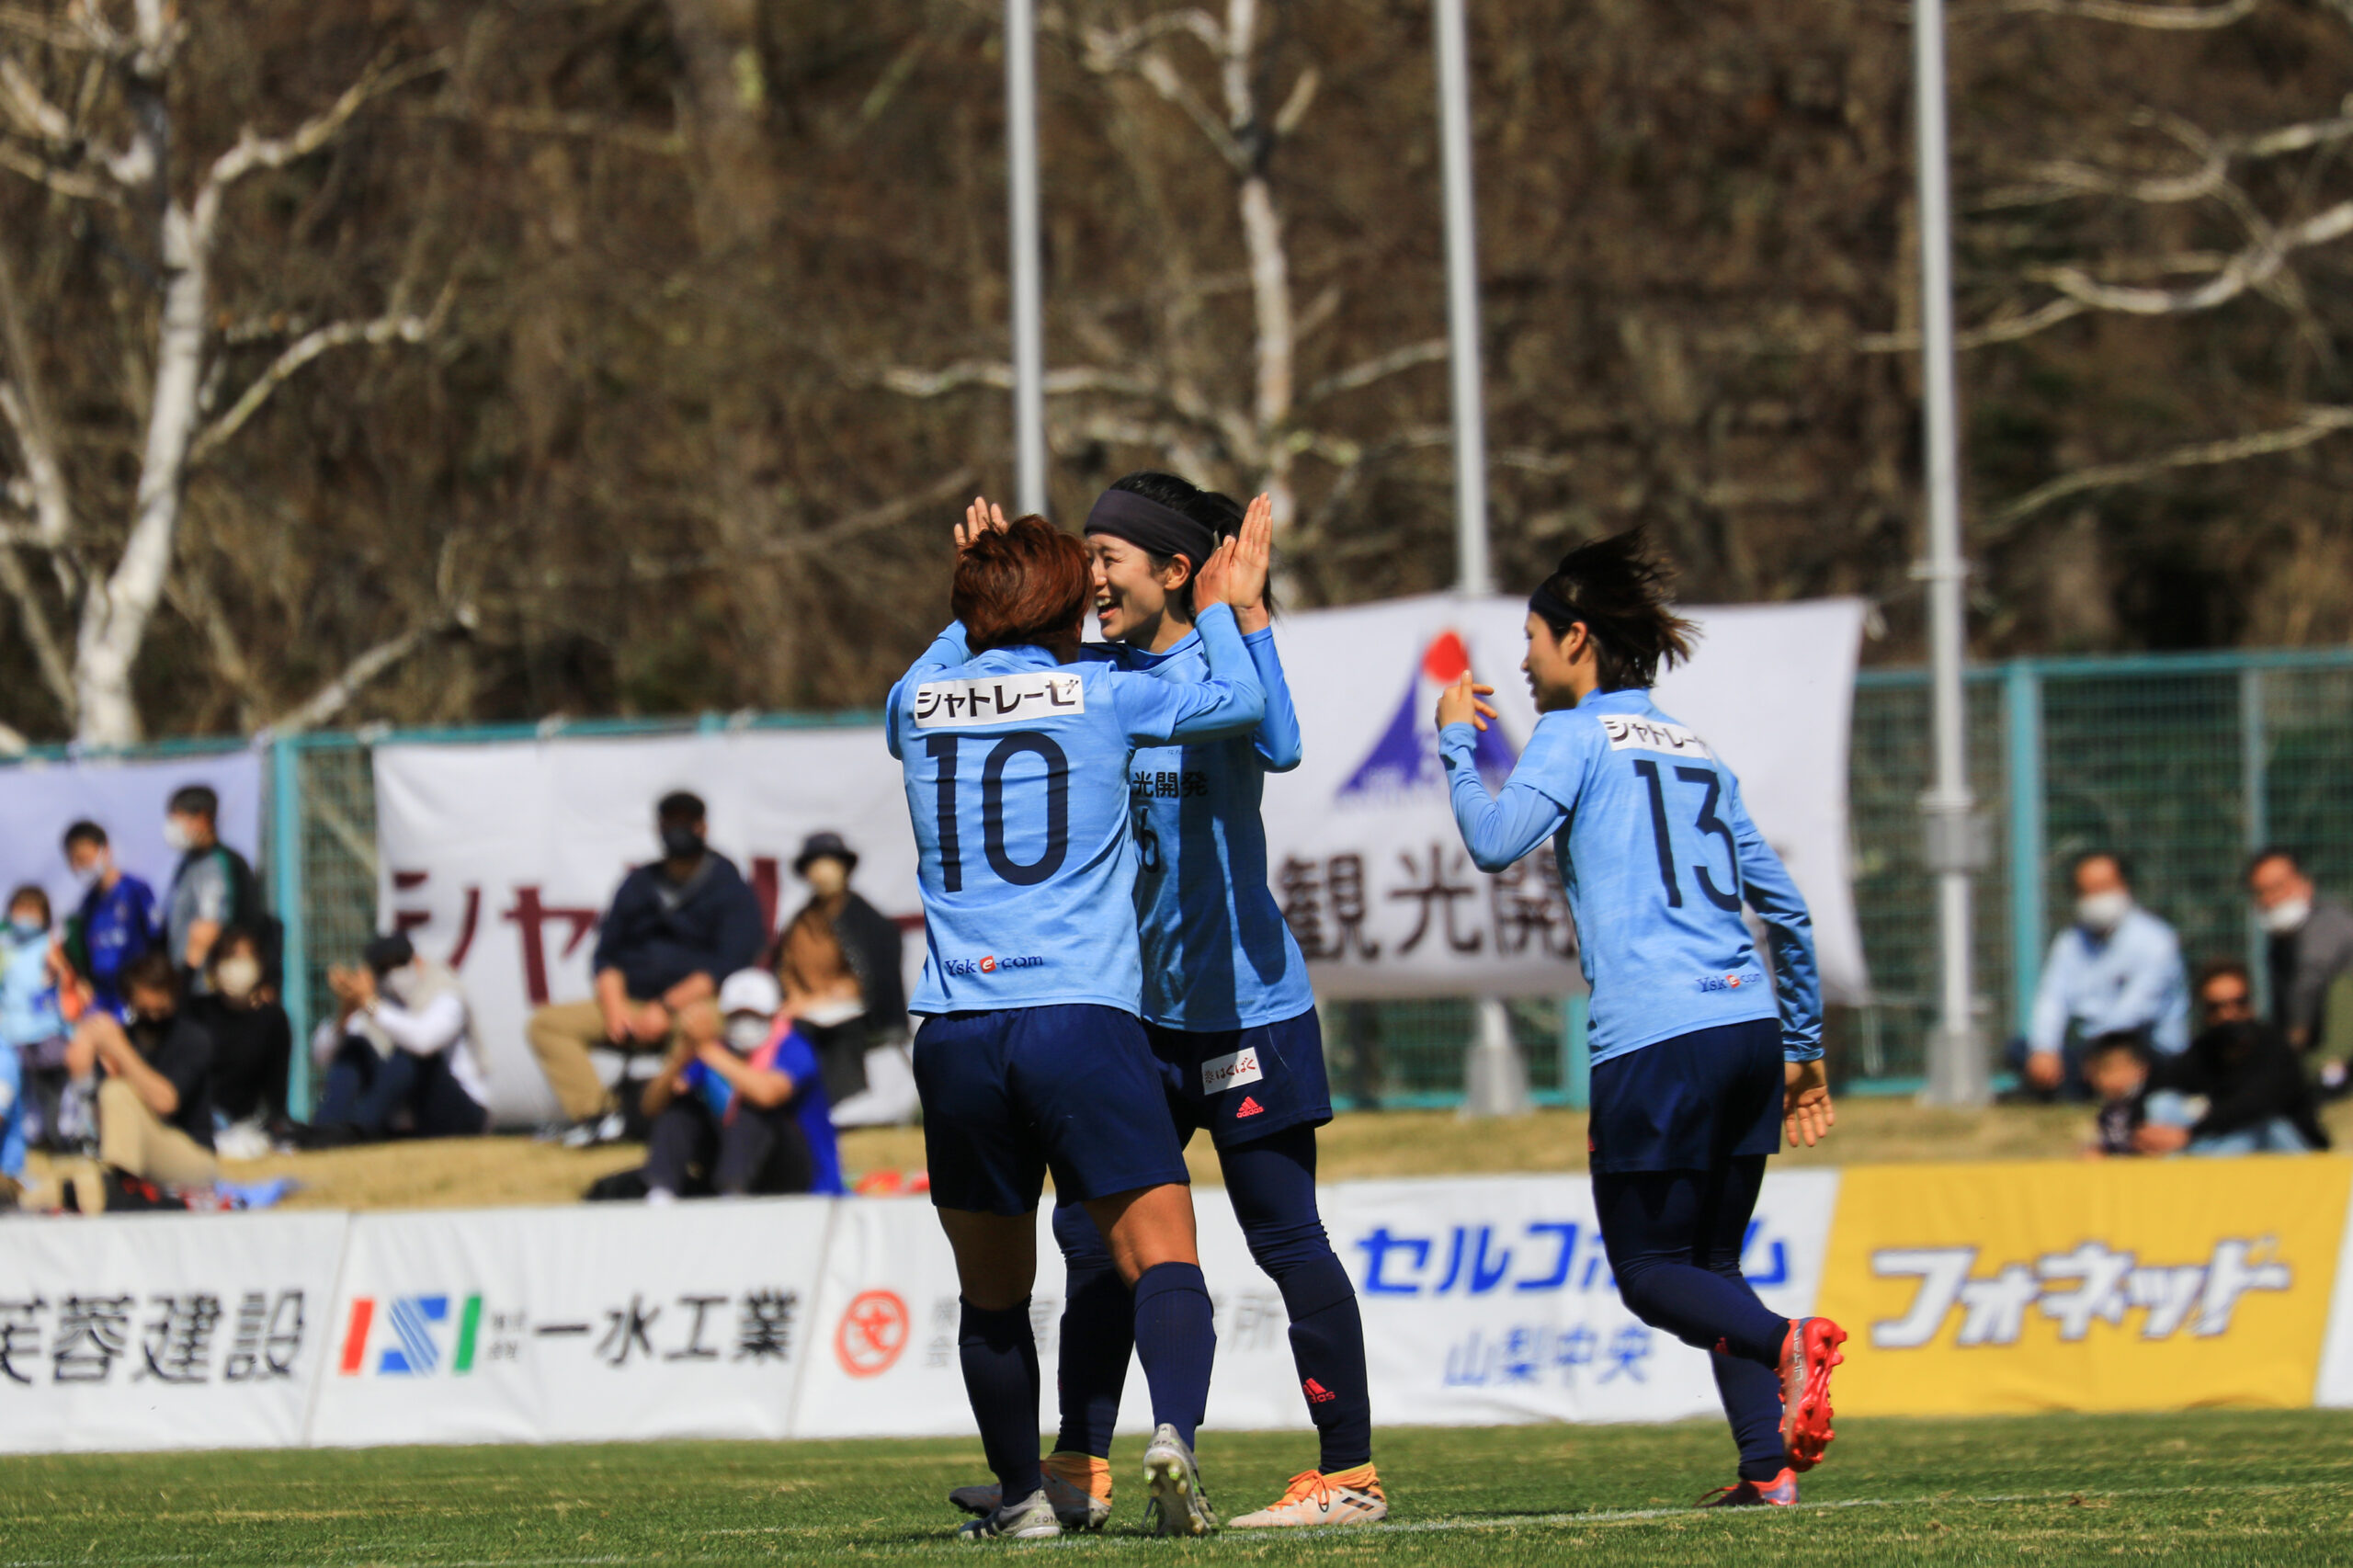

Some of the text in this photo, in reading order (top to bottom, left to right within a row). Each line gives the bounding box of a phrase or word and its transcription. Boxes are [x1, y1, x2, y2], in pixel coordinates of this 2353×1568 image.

[916, 679, 1080, 720] シャトレーゼ
[1131, 770, 1208, 798] 光開発
[926, 731, 1068, 892] 10
[1632, 759, 1742, 912] 13
[945, 959, 977, 976] Ysk
[1695, 976, 1727, 993] Ysk
[1236, 1106, 1265, 1119] adidas
[533, 1289, 798, 1368] 一水工業
